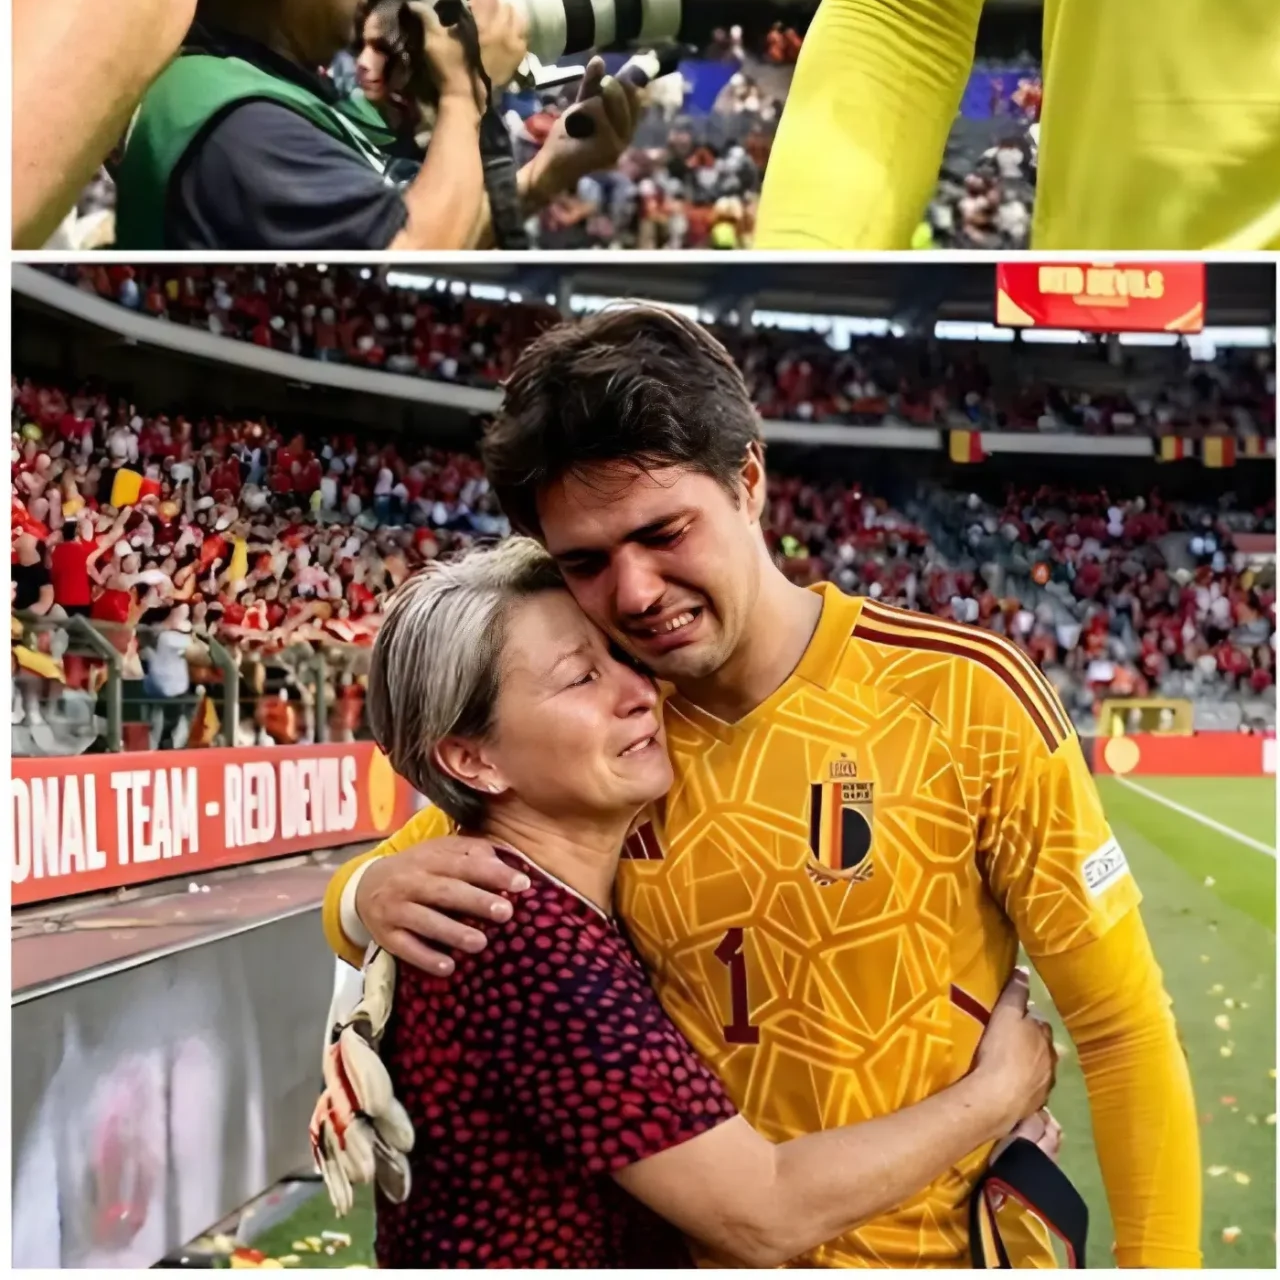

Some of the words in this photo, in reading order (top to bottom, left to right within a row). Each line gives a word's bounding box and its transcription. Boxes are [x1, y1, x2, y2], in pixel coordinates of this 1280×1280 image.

[110, 766, 199, 865] TEAM
[224, 761, 276, 848] RED
[280, 755, 357, 840] DEVILS
[713, 927, 760, 1044] 1
